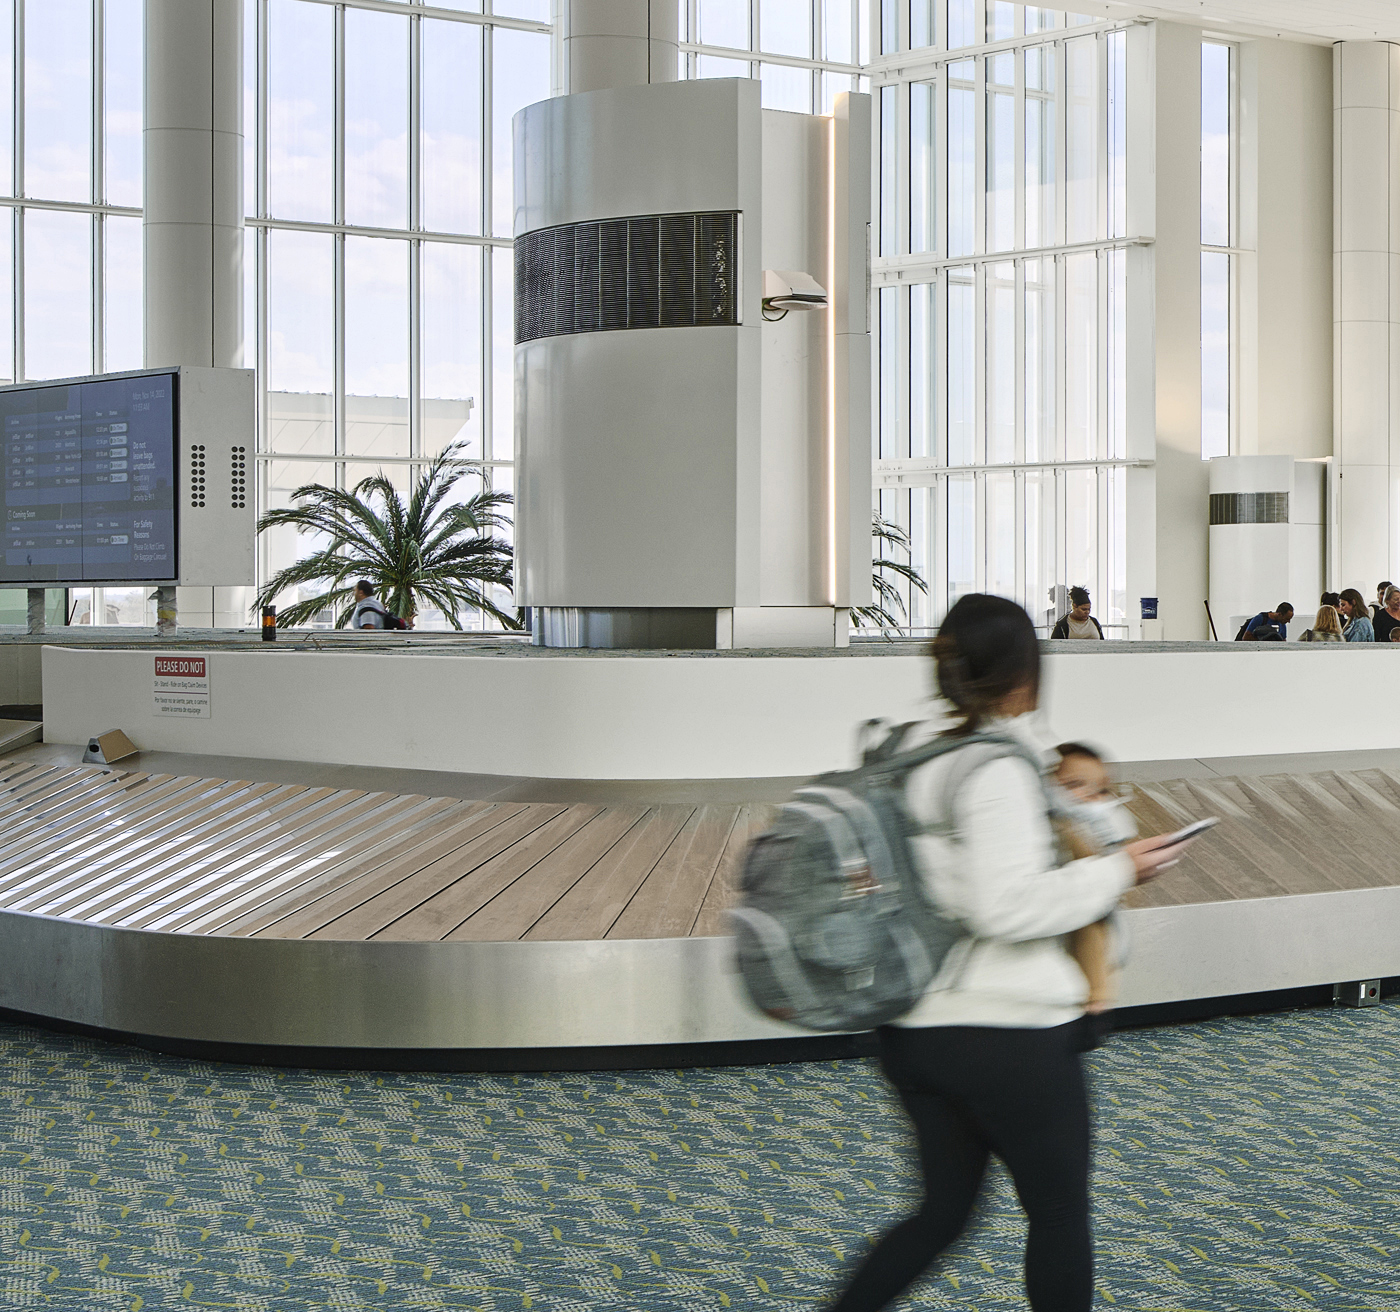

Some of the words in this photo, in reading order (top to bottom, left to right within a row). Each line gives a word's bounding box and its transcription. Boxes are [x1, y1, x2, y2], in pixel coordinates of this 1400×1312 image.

[12, 510, 27, 520] Coming
[26, 510, 36, 518] Soon
[133, 520, 141, 528] For
[140, 519, 153, 530] Safety
[157, 661, 178, 672] PLEASE
[179, 661, 189, 673] DO
[190, 662, 203, 673] NOT
